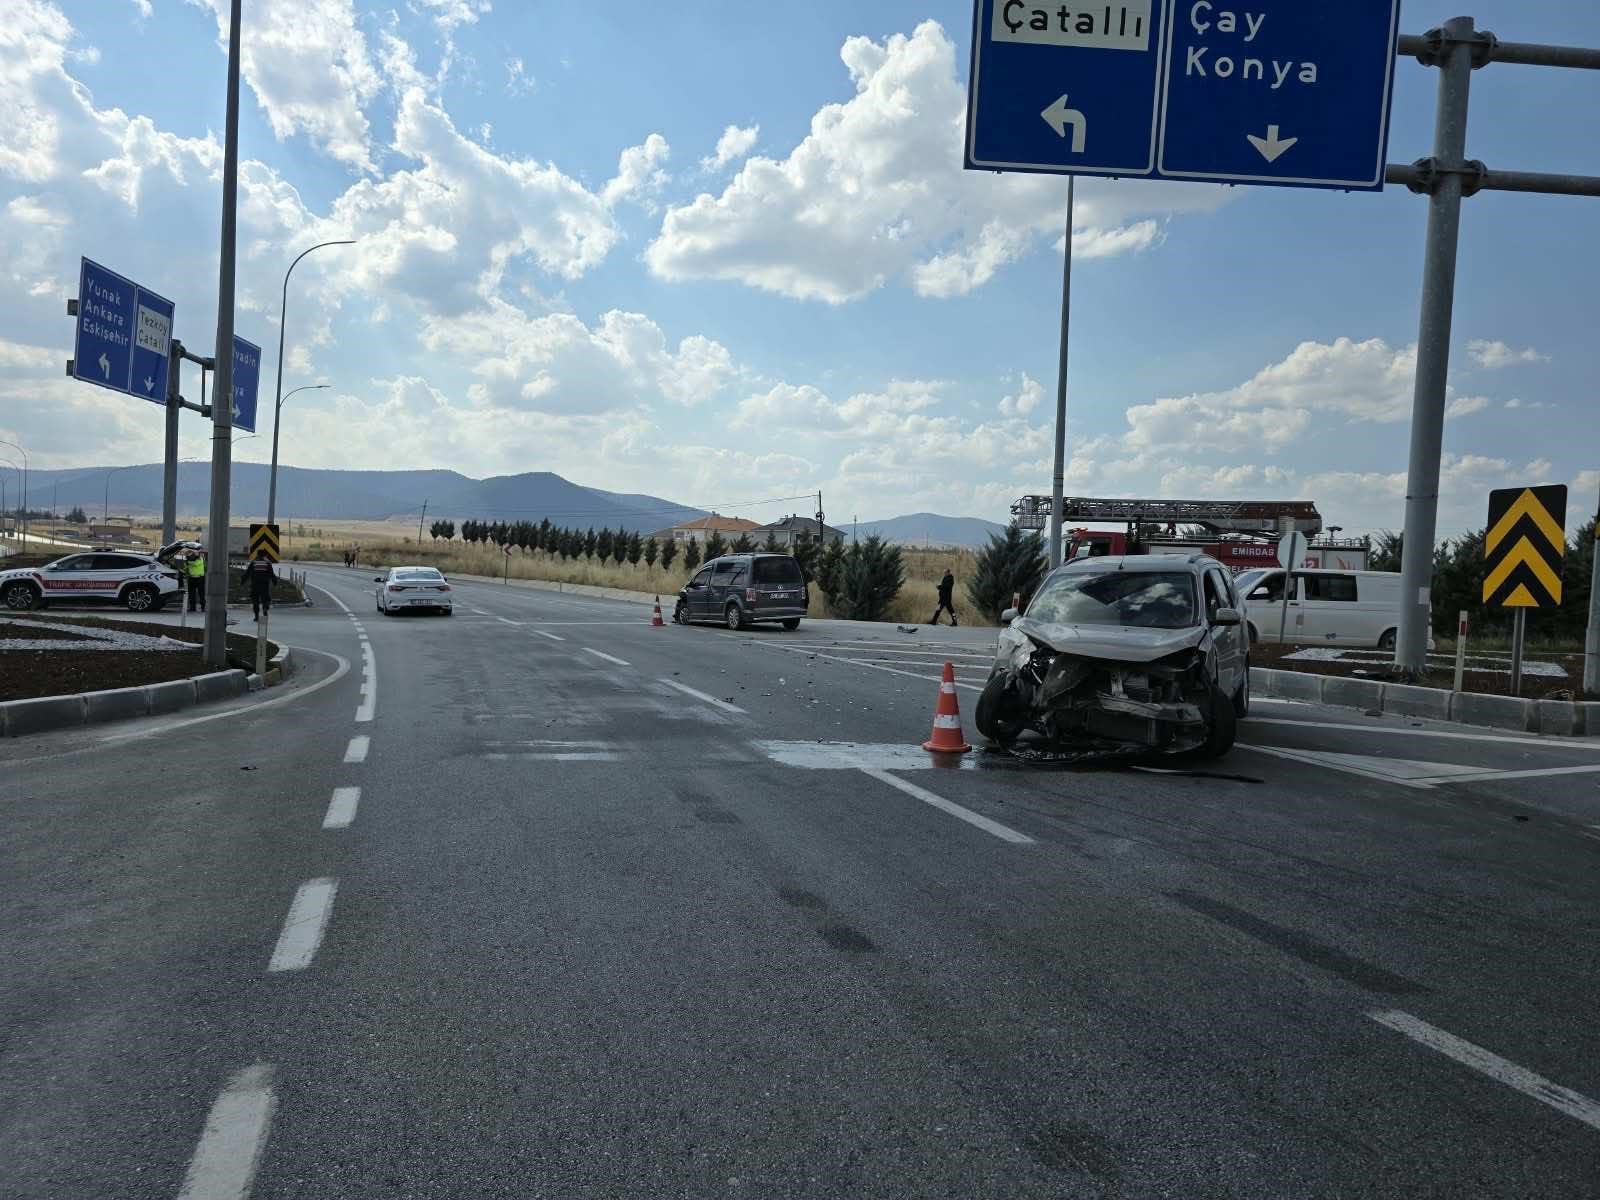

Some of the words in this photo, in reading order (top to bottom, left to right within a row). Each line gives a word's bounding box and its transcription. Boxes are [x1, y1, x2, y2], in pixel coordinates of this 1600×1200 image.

[1003, 0, 1142, 37] Çatallı
[1190, 1, 1266, 42] Çay
[1186, 46, 1317, 89] Konya
[87, 277, 121, 306] Yunak
[85, 298, 124, 326] Ankara
[83, 319, 129, 345] Eskişehir
